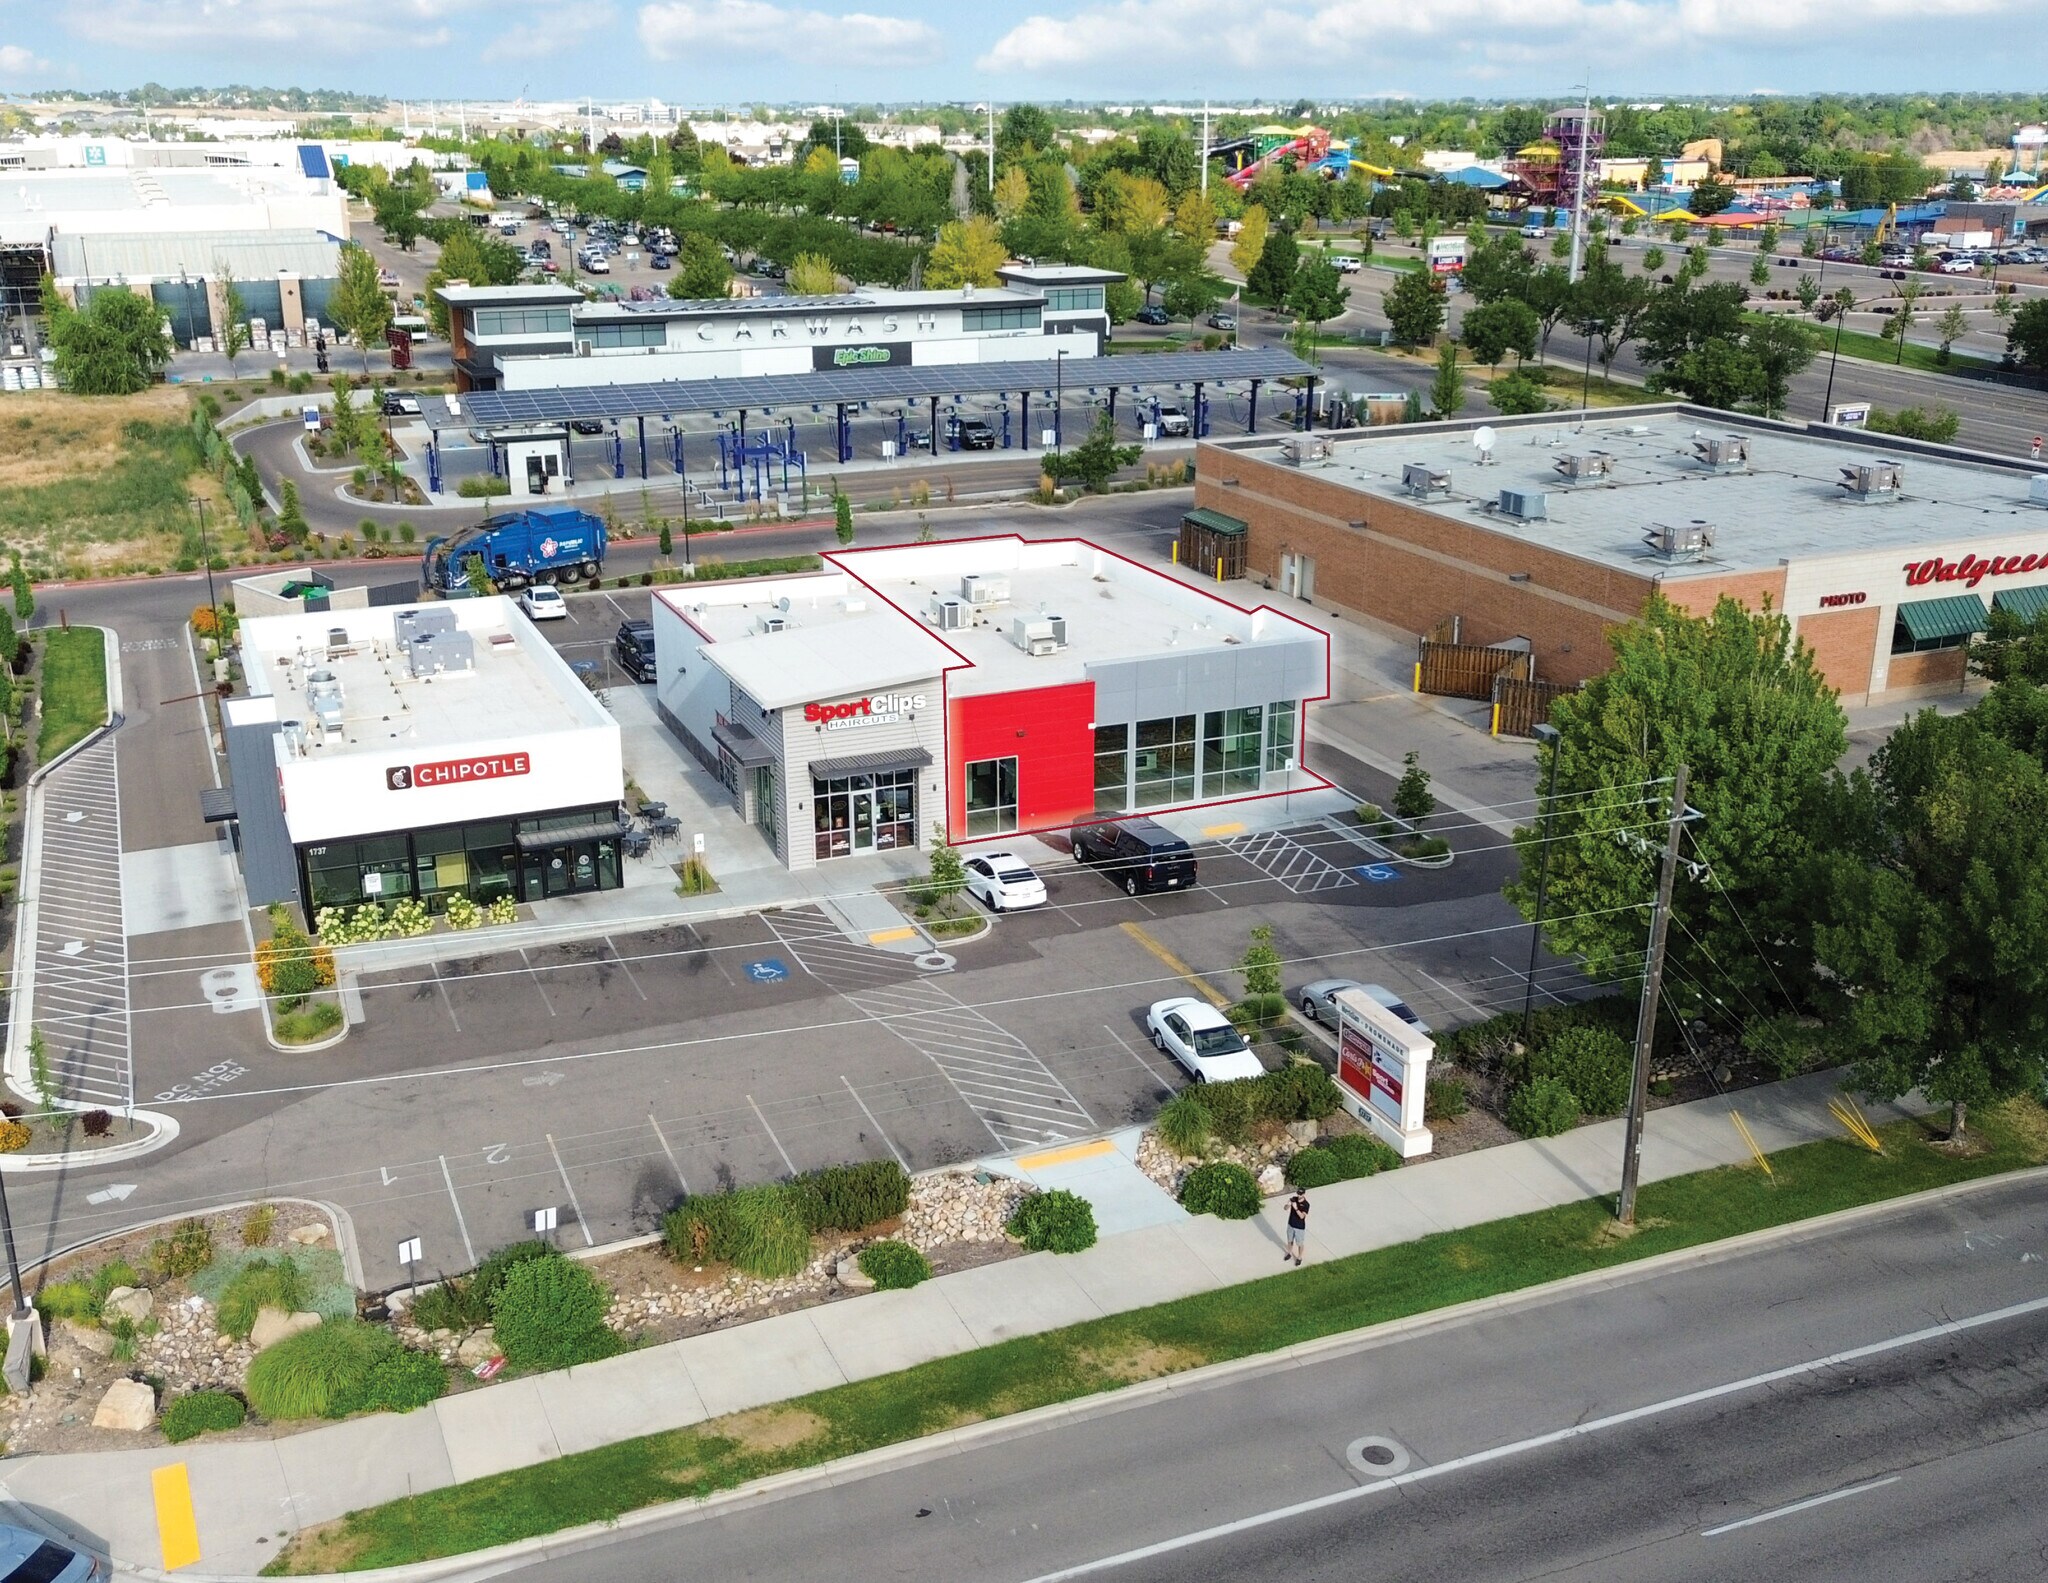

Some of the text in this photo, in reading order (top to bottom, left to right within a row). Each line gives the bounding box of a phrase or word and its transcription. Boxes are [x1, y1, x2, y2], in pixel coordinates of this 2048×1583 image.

[834, 347, 890, 365] Epic Shine
[1819, 592, 1867, 608] PHOTO
[829, 714, 897, 728] HAIRCUTS
[419, 756, 527, 783] CHIPOTLE
[309, 846, 327, 856] 1737
[154, 1058, 238, 1101] DO NOT
[175, 1066, 251, 1103] ENTER
[482, 1143, 511, 1164] 2
[380, 1166, 398, 1186] 1
